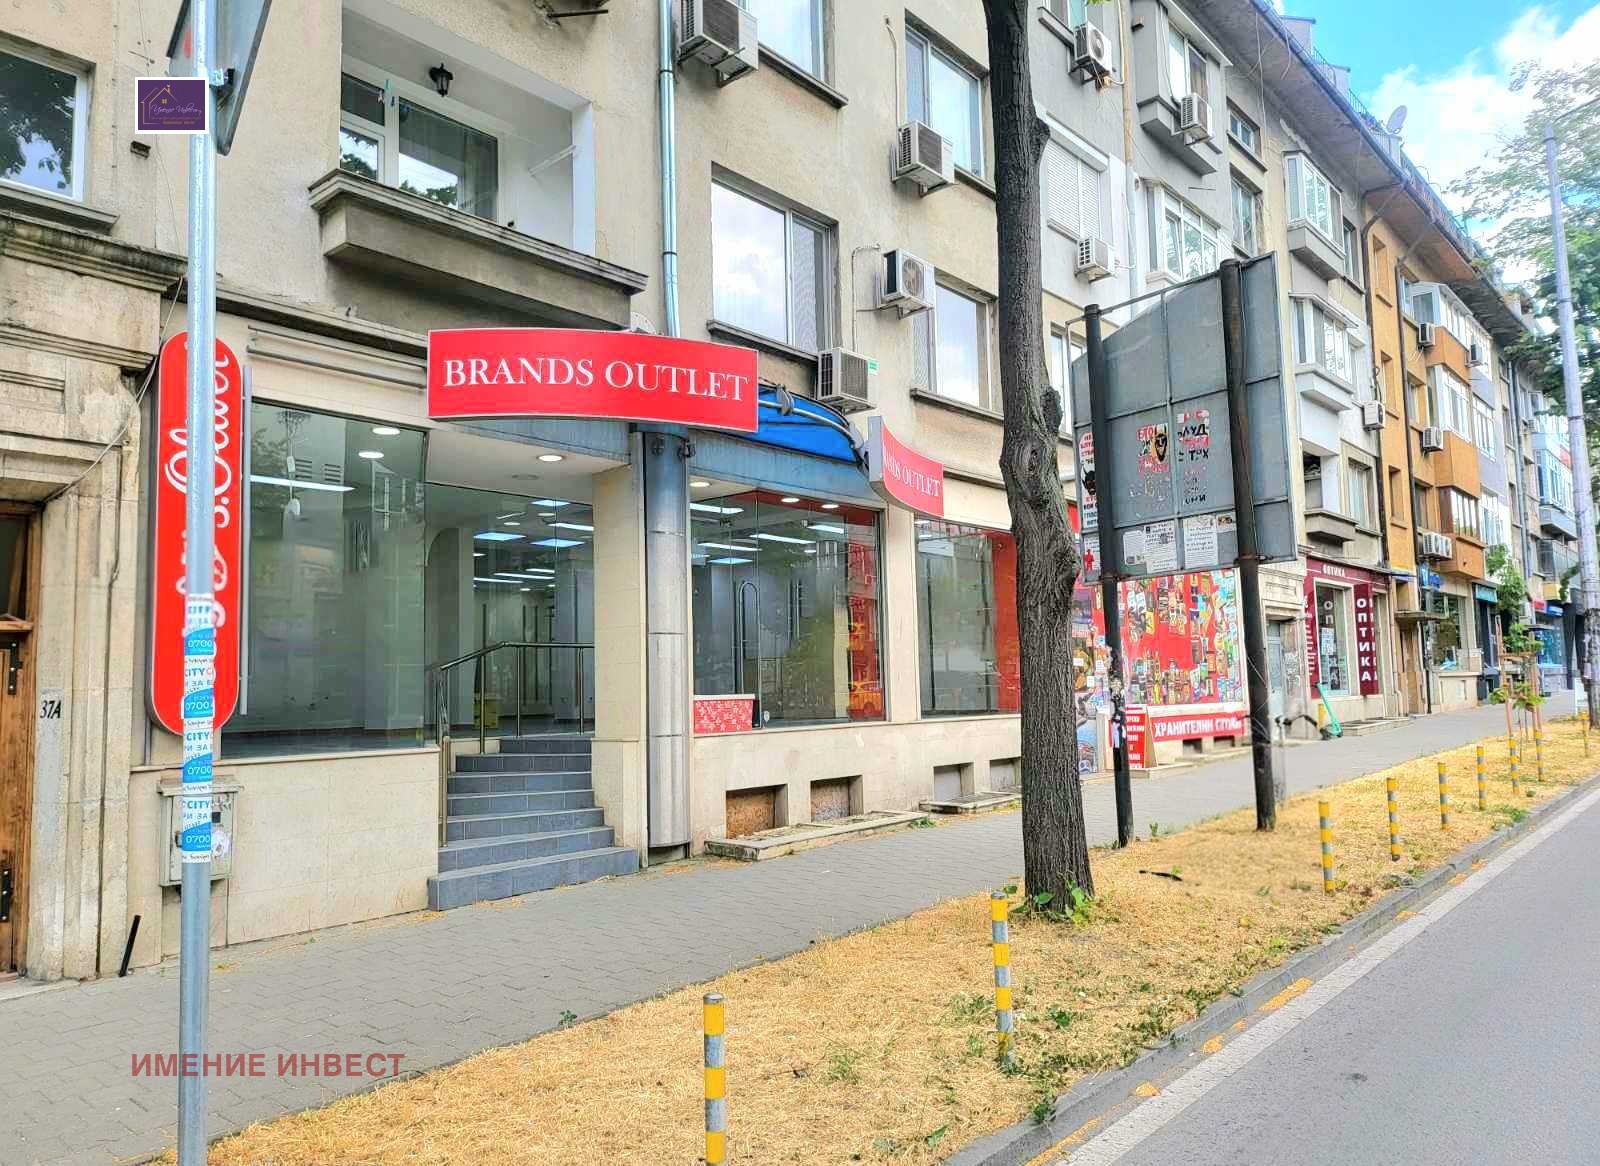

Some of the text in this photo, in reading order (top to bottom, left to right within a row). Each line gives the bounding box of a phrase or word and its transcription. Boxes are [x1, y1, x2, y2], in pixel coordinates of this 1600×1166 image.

[443, 357, 749, 401] BRANDS OUTLET
[902, 465, 941, 497] OUTLET
[1356, 598, 1372, 681] ОПТИКА
